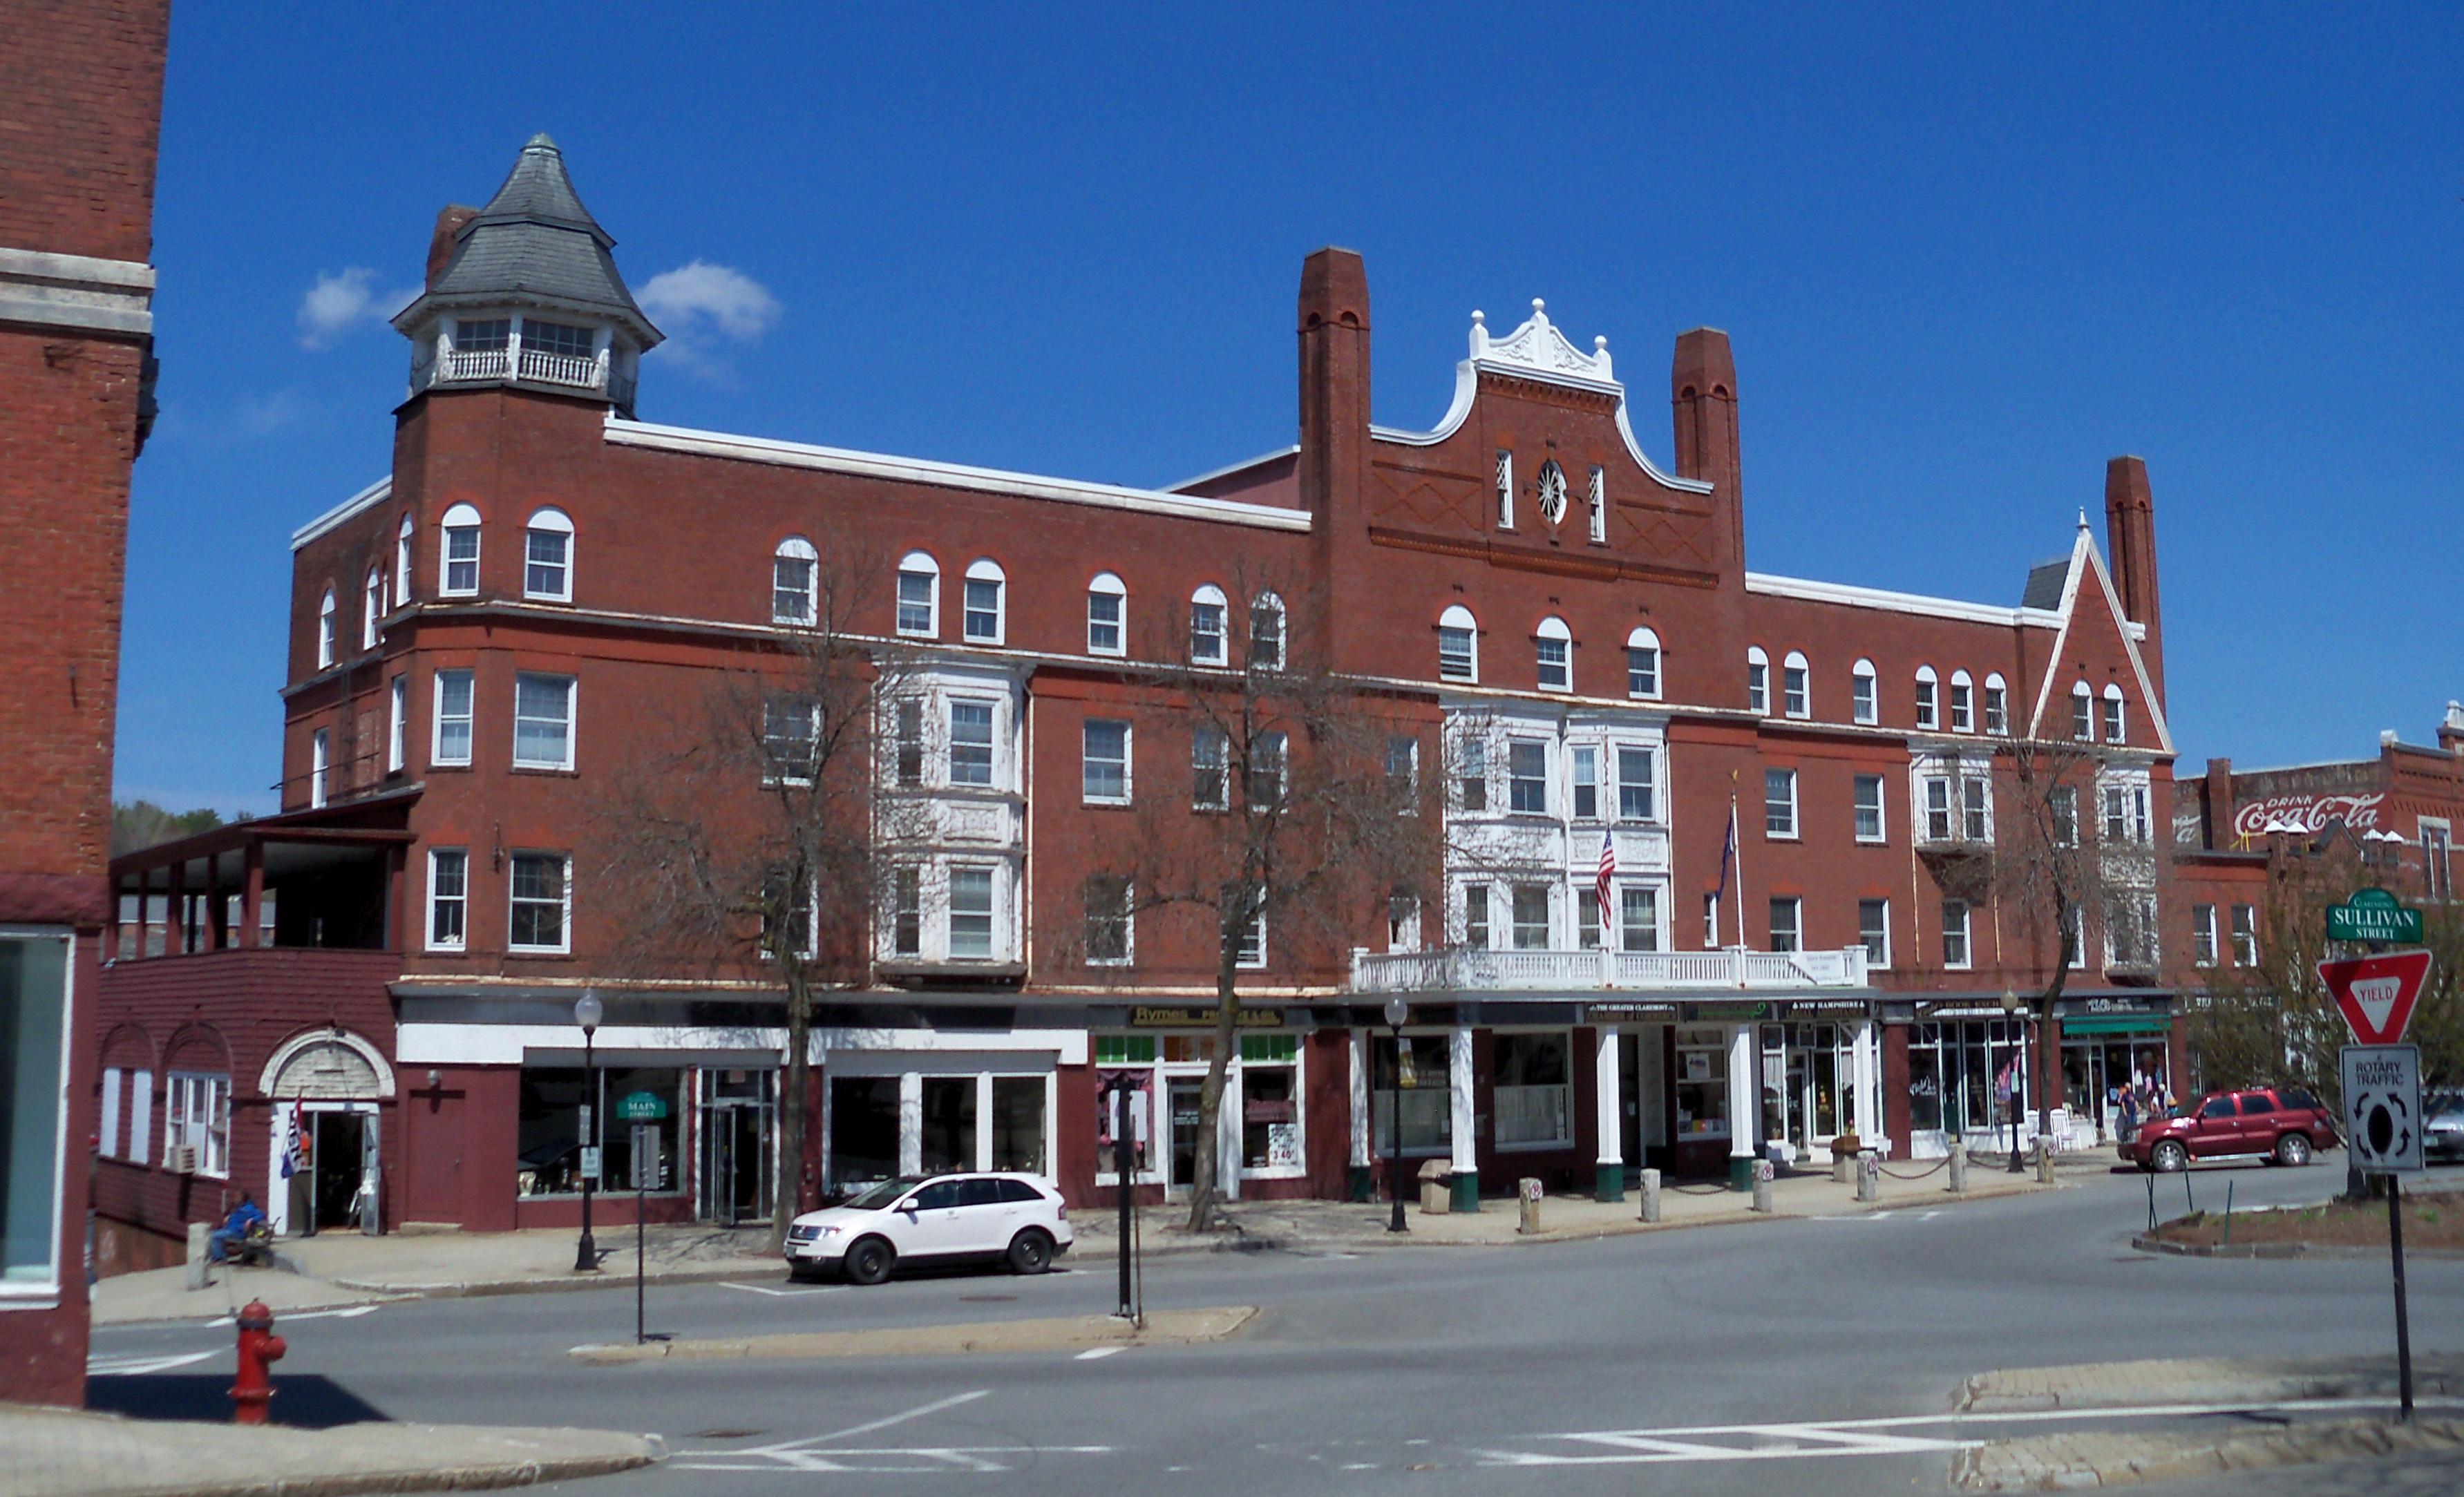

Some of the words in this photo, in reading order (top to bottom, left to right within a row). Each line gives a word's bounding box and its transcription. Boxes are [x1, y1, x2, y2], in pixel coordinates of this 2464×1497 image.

[2266, 794, 2313, 808] DRINK
[2335, 909, 2414, 927] SULLIVAN
[2356, 927, 2395, 940] STREET
[2359, 984, 2393, 1002] YIELD
[1817, 1000, 1859, 1009] HAMPSHIRE
[1136, 1005, 1188, 1020] Rymes
[2355, 1061, 2401, 1073] ROTARY
[2356, 1074, 2405, 1087] TRAFFIC
[627, 1102, 656, 1110] MAIN
